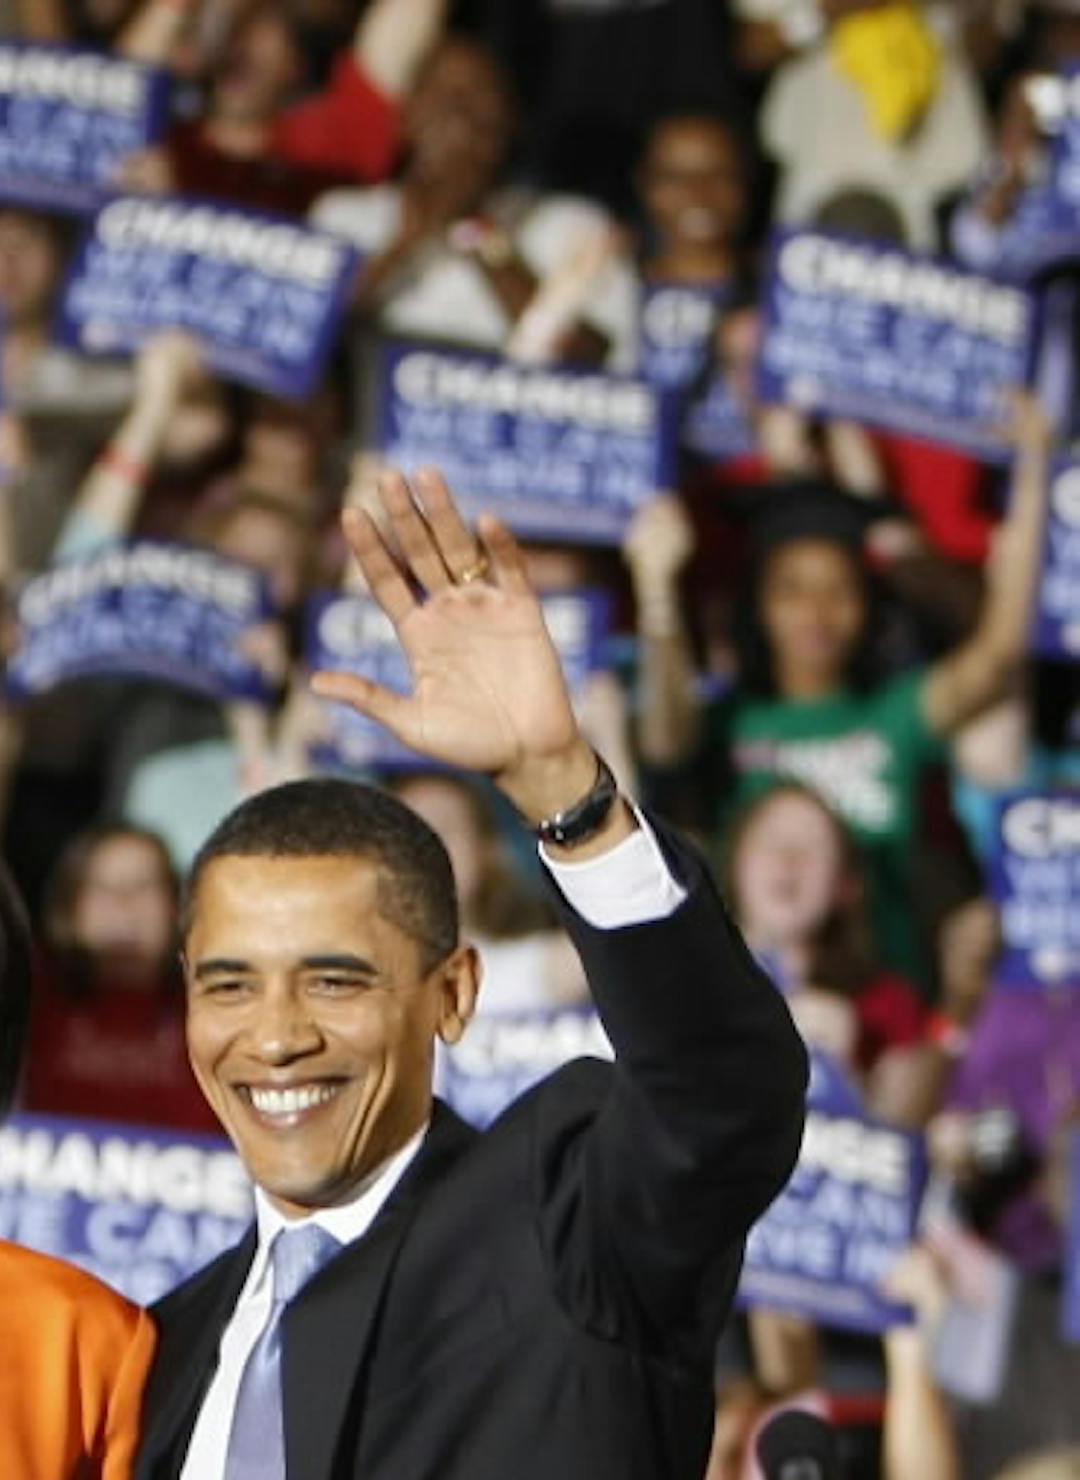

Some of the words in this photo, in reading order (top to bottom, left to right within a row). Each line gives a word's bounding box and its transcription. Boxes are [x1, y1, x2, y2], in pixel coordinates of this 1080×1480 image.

[96, 199, 344, 292] CHANGE
[778, 233, 1030, 346] CHANGE
[392, 350, 658, 432] CHANGE
